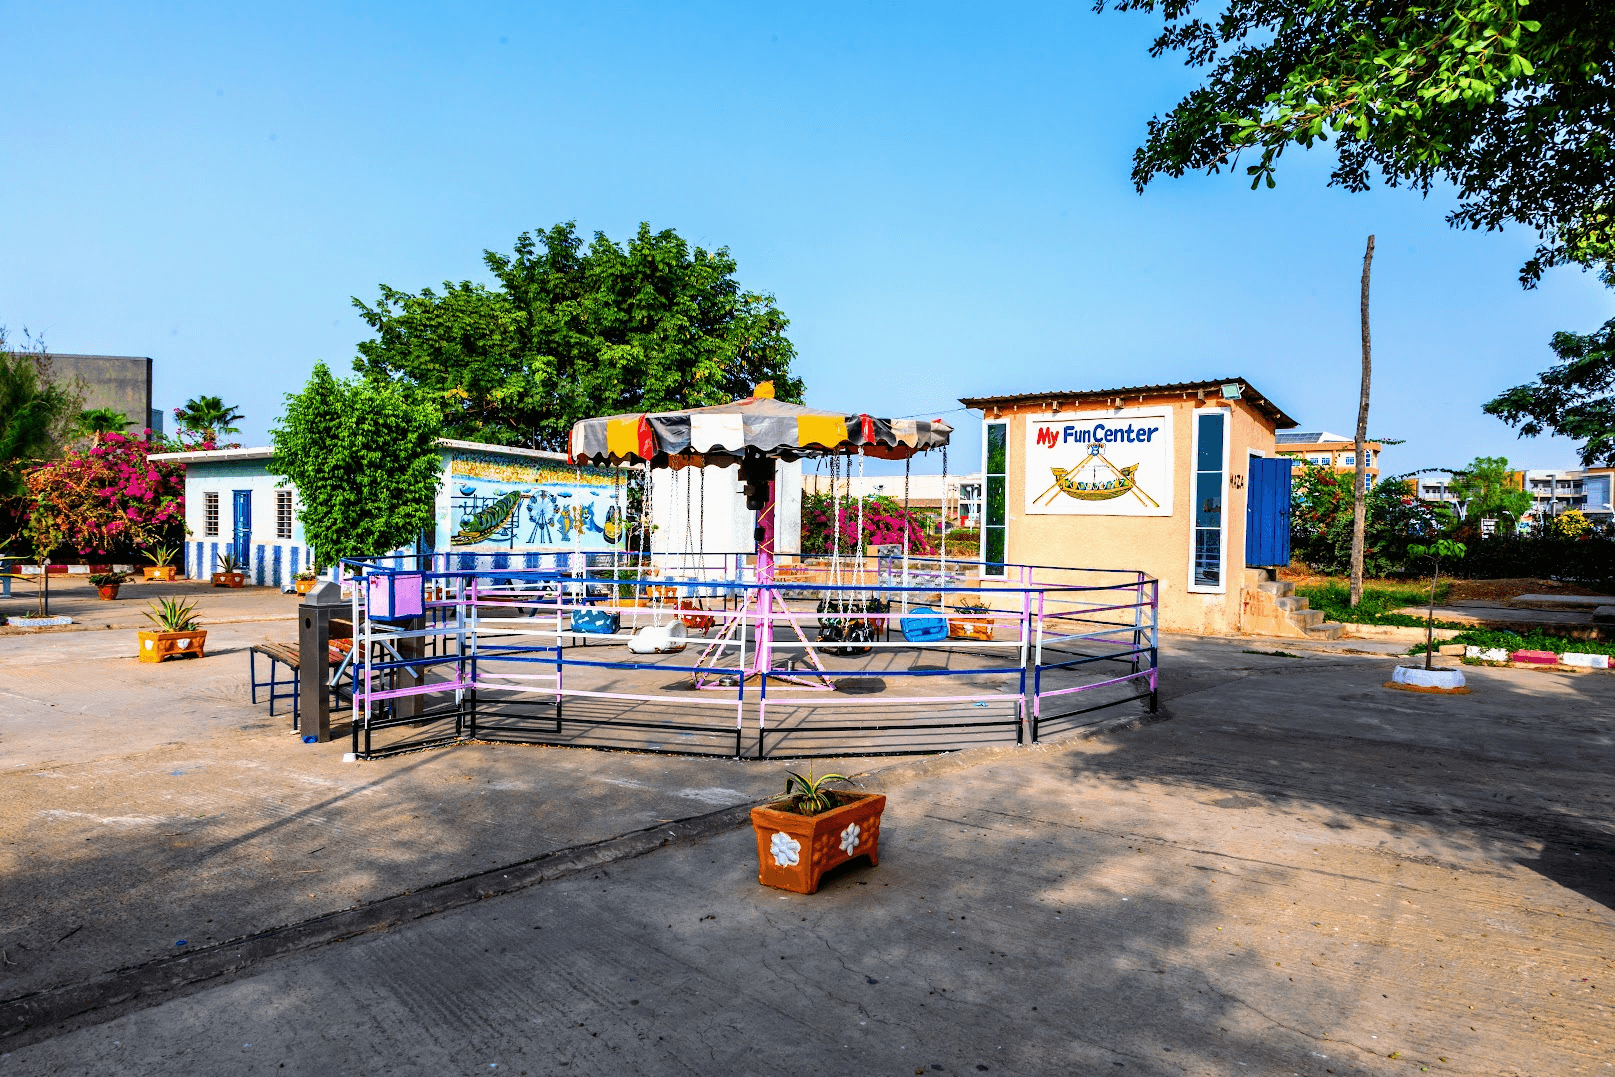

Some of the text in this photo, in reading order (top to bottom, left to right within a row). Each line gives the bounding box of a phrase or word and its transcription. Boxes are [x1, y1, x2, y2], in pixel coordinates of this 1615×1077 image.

[1036, 423, 1159, 449] My Fun Center
